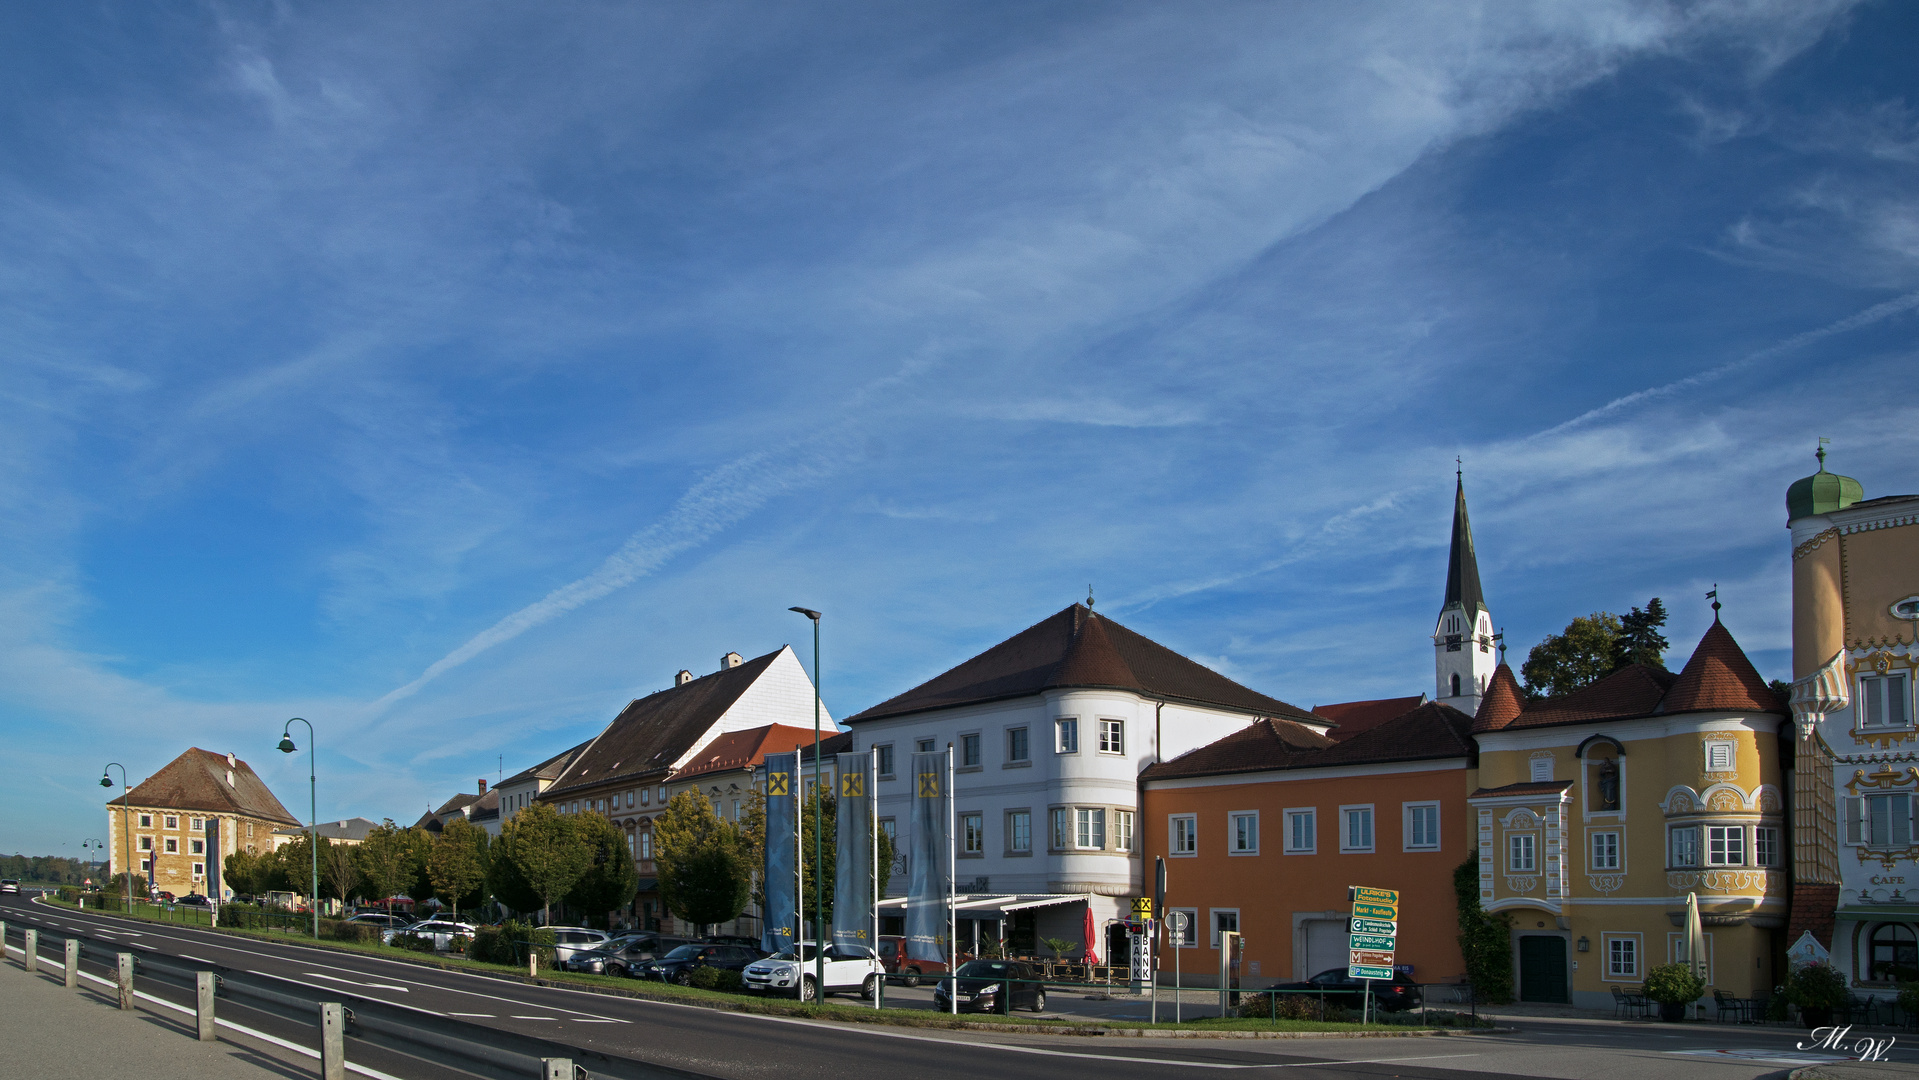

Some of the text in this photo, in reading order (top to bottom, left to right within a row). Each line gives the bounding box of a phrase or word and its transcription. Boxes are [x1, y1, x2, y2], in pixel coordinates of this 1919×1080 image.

[1870, 875, 1905, 885] CAFE
[1358, 894, 1393, 904] Fotostudio
[1356, 906, 1369, 914] Markt
[1373, 908, 1392, 916] Kaufleute
[1361, 968, 1384, 977] Donausteig
